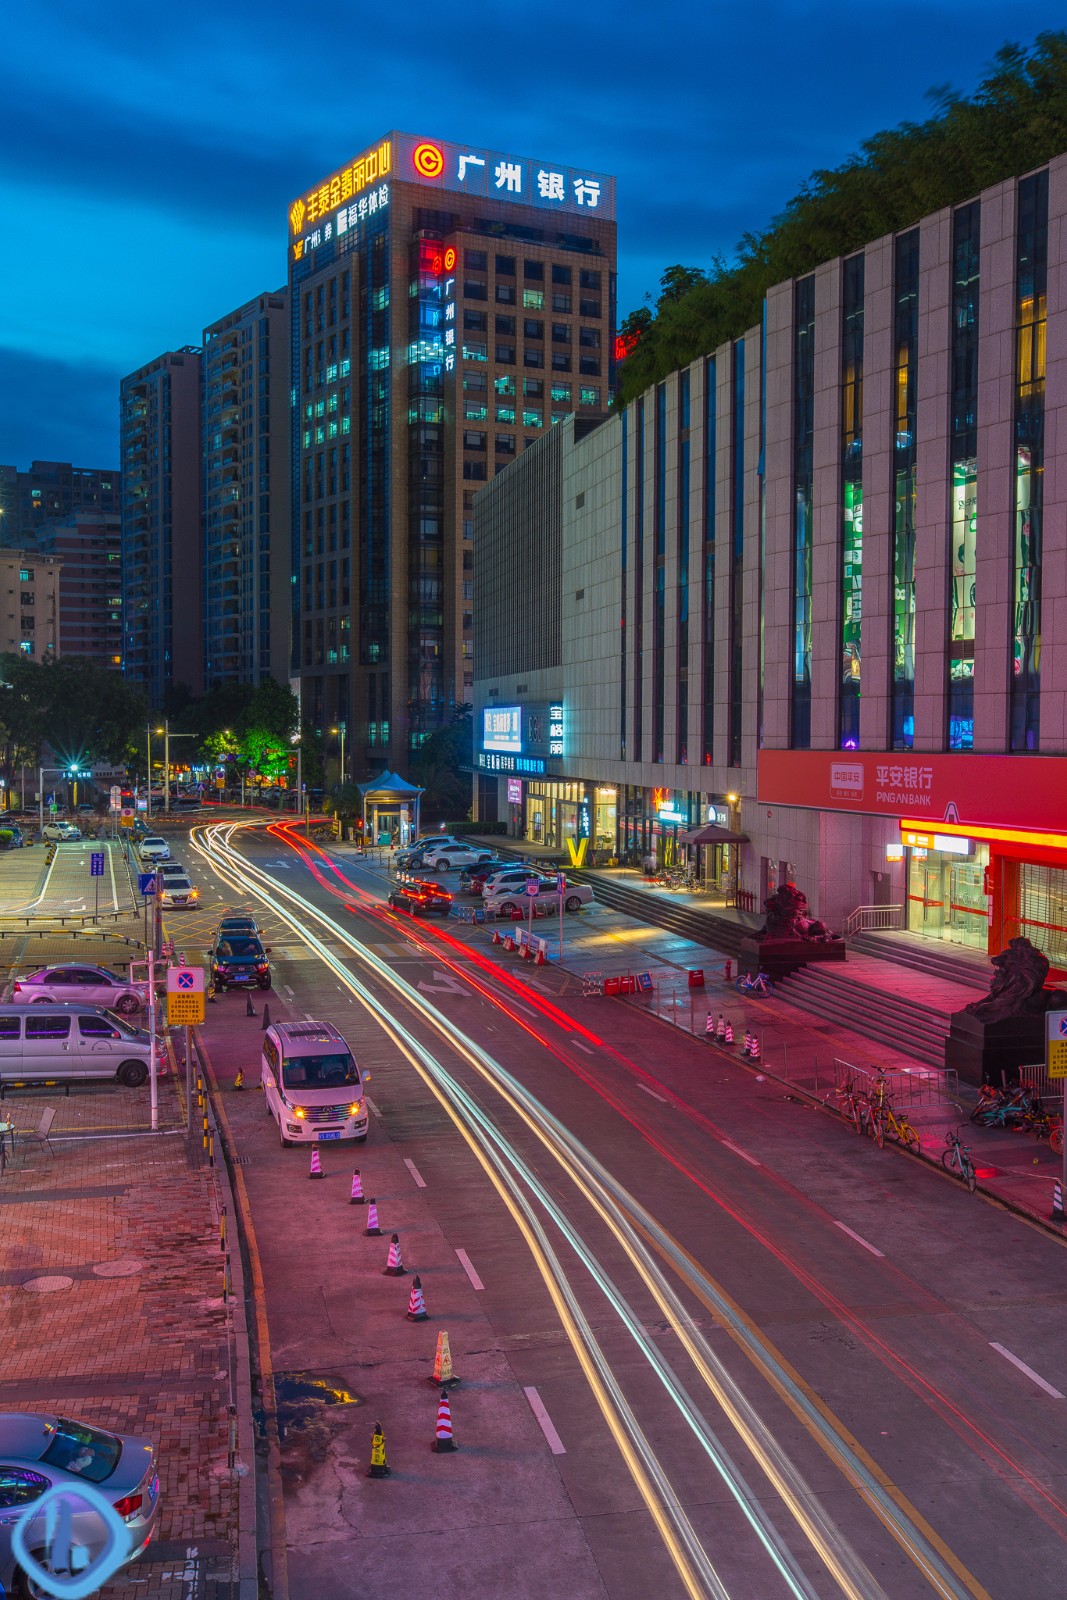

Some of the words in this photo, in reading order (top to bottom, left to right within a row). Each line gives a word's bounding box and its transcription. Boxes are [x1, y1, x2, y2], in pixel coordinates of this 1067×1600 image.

[457, 154, 602, 208] 广州银行
[348, 183, 389, 228] 福华体检
[444, 277, 455, 372] 广州银行
[834, 771, 860, 783] 中国平安
[876, 765, 933, 789] 平安银行
